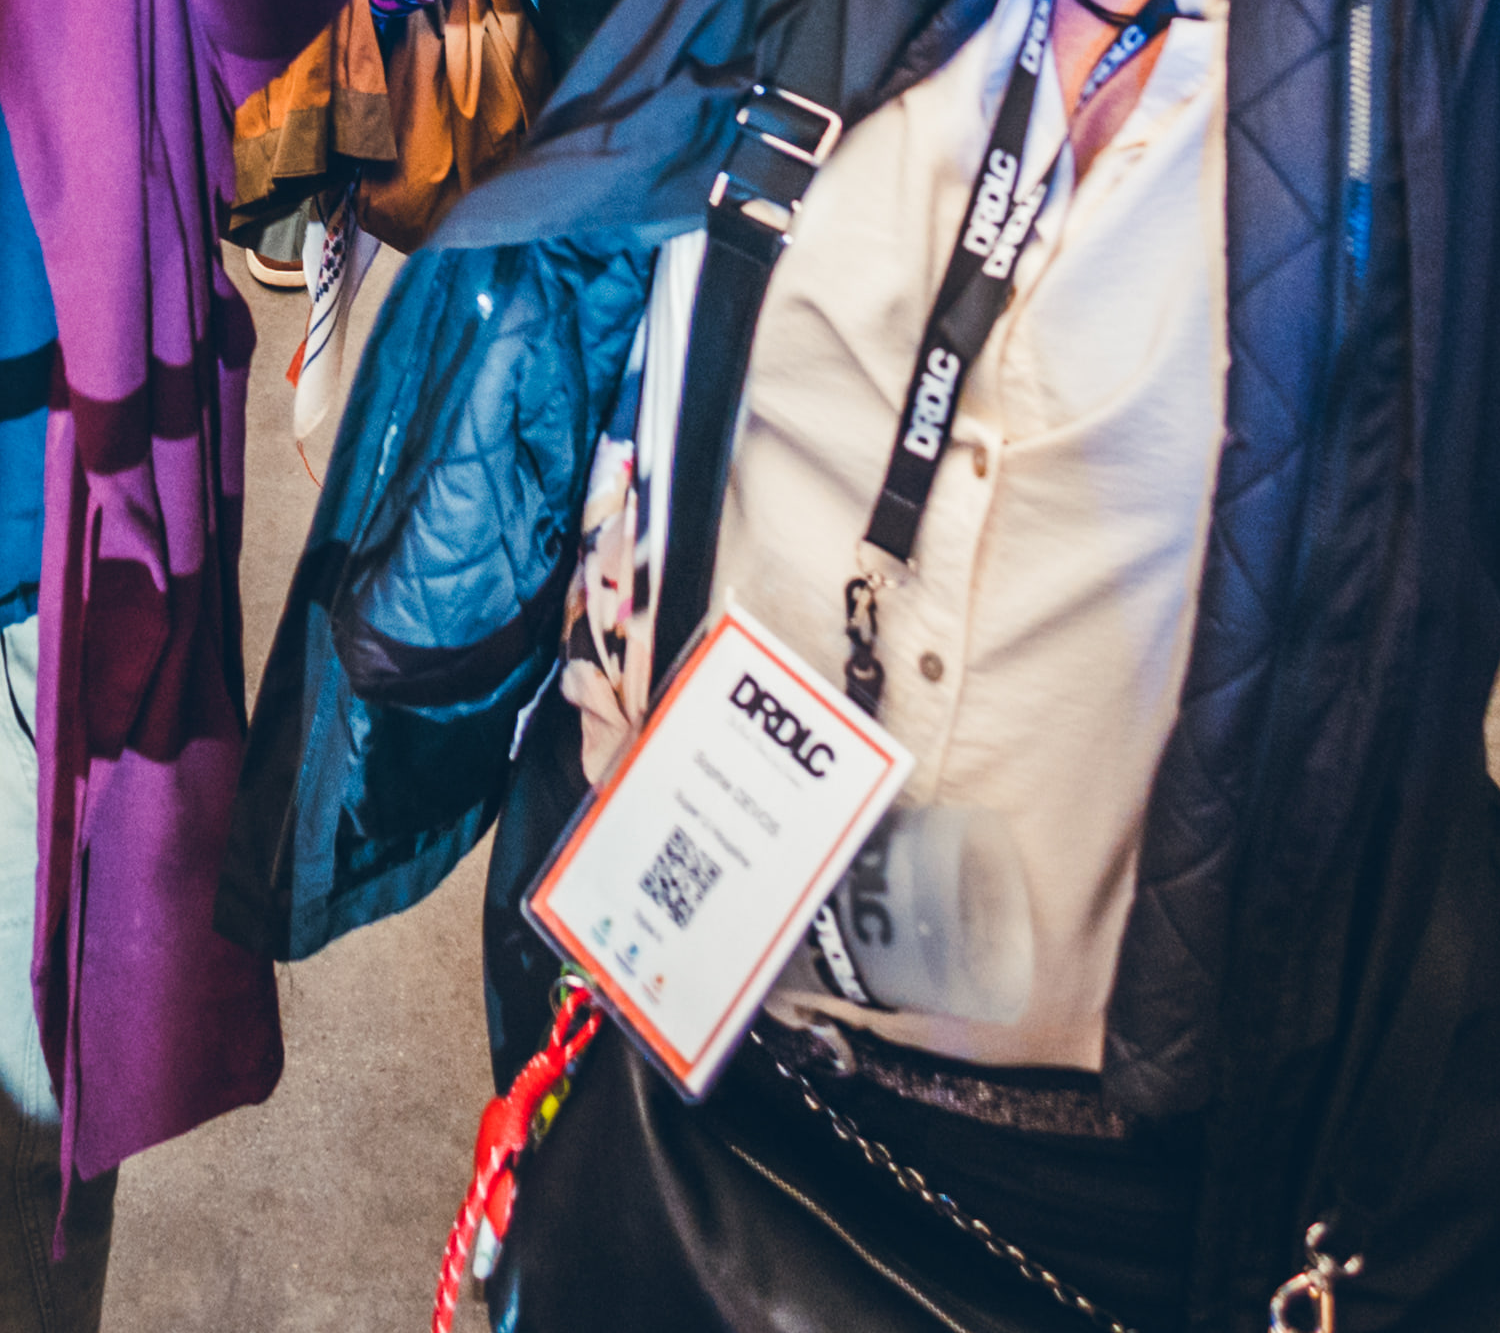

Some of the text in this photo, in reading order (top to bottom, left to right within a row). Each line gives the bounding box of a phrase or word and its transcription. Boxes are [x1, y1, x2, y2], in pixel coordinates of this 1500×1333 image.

[962, 148, 1018, 258] DRDLC
[903, 347, 961, 462] DRDLC
[729, 672, 836, 777] DRDLC
